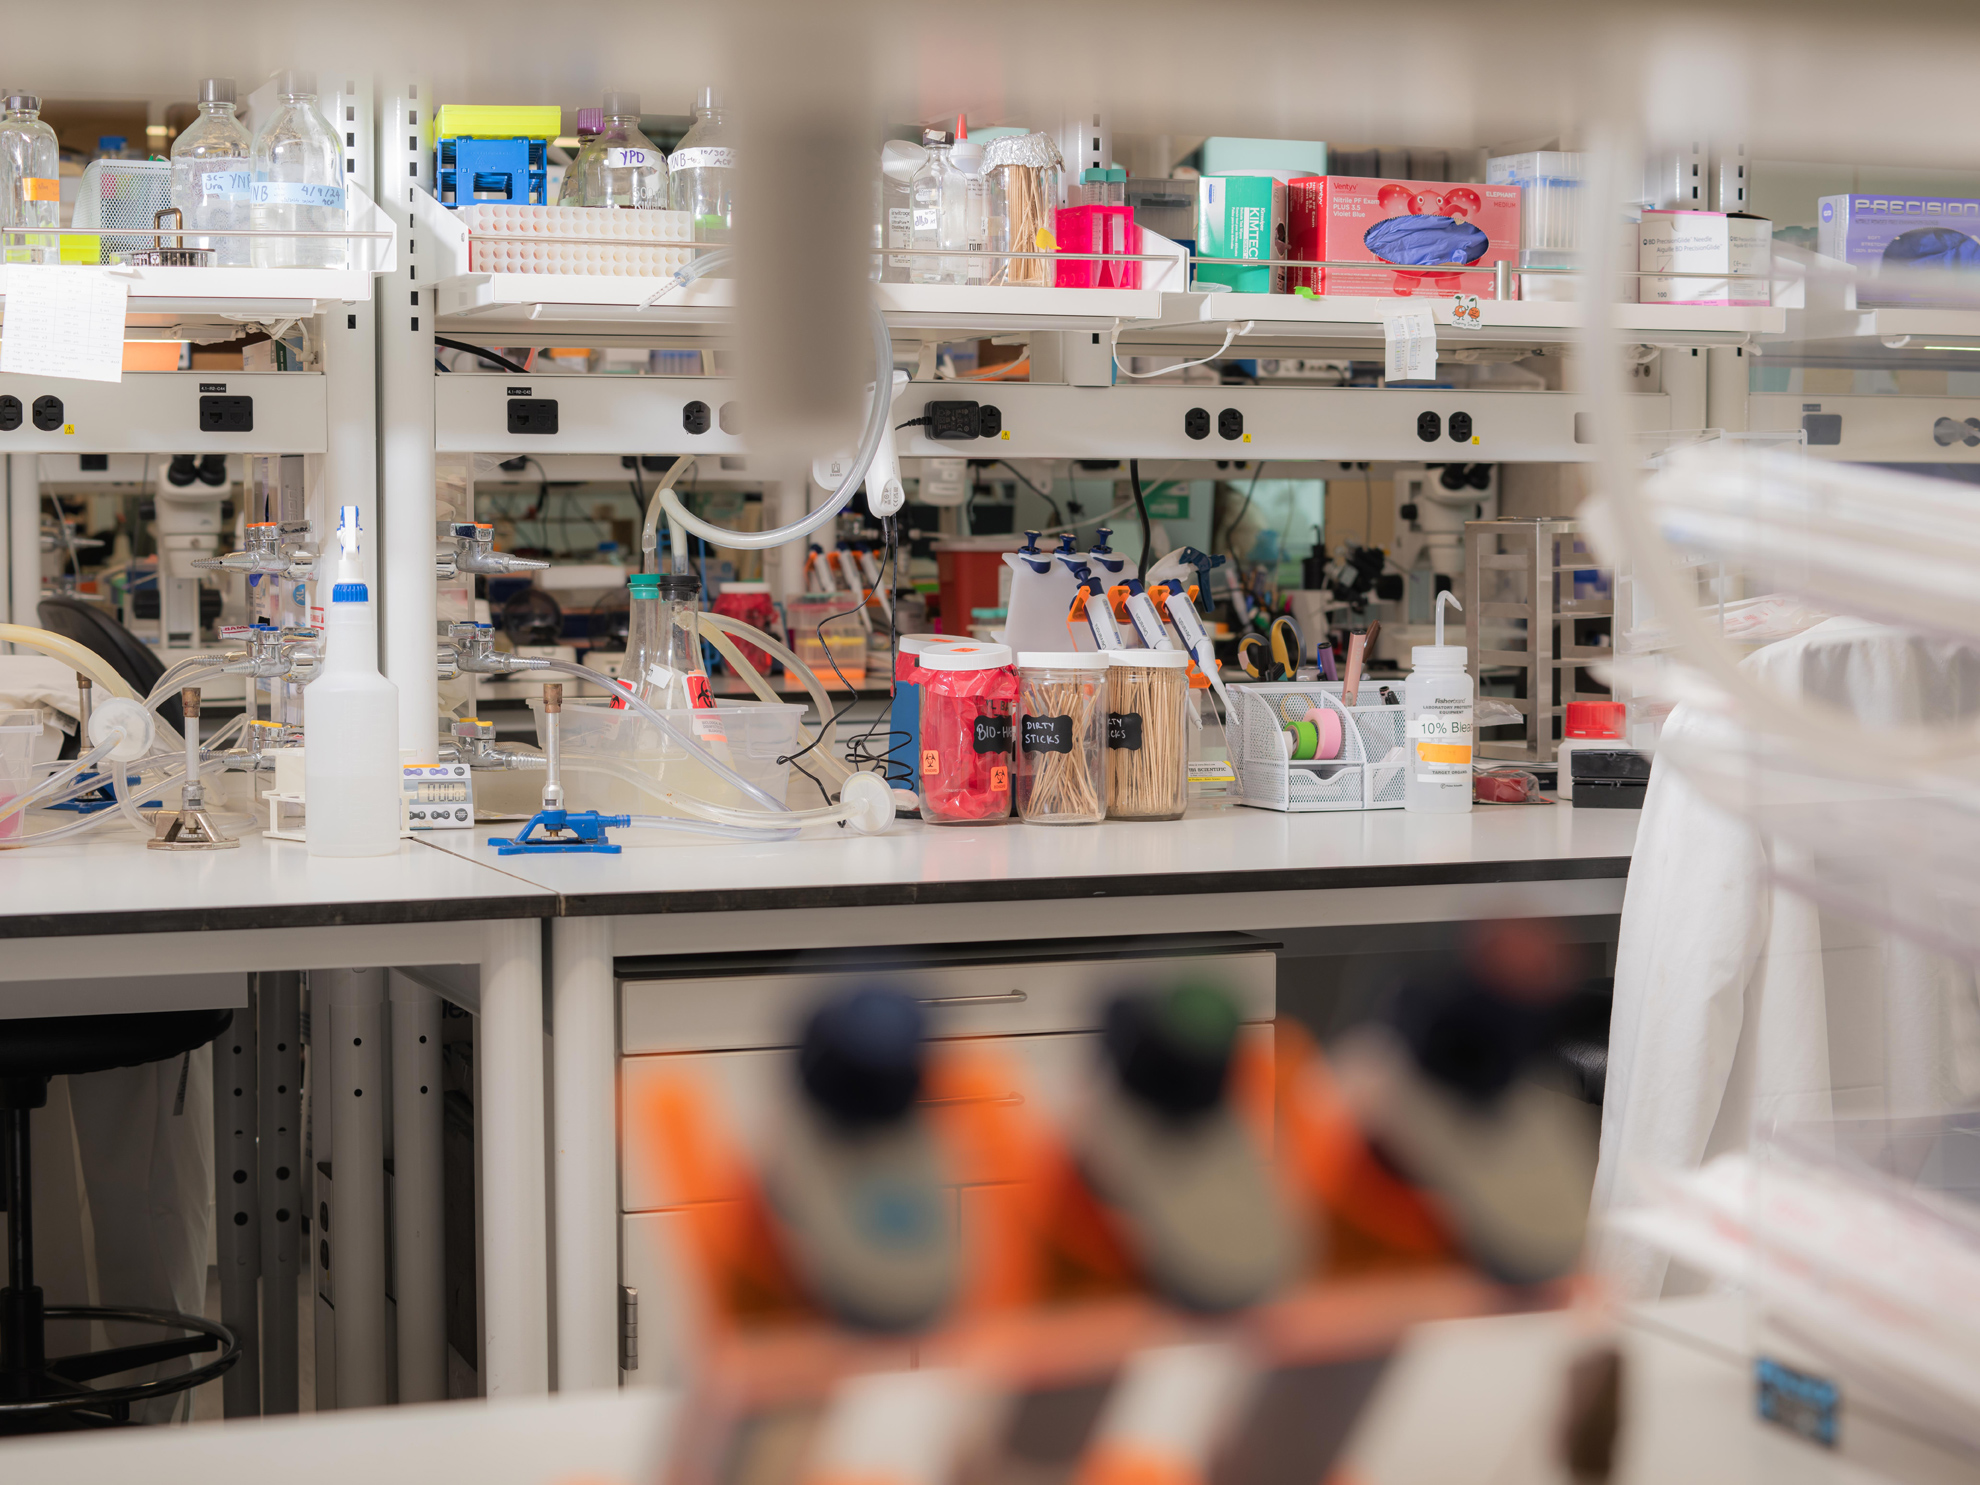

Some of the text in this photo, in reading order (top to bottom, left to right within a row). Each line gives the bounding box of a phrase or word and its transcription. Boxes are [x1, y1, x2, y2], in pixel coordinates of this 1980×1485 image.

[620, 150, 645, 165] YPD
[1333, 182, 1358, 190] Ventyv
[250, 185, 268, 202] NB
[1855, 199, 1978, 216] PRECISION
[296, 589, 304, 601] XL
[1026, 722, 1054, 731] DIRTY
[1421, 722, 1447, 734] 10%
[1025, 734, 1060, 744] STICKS
